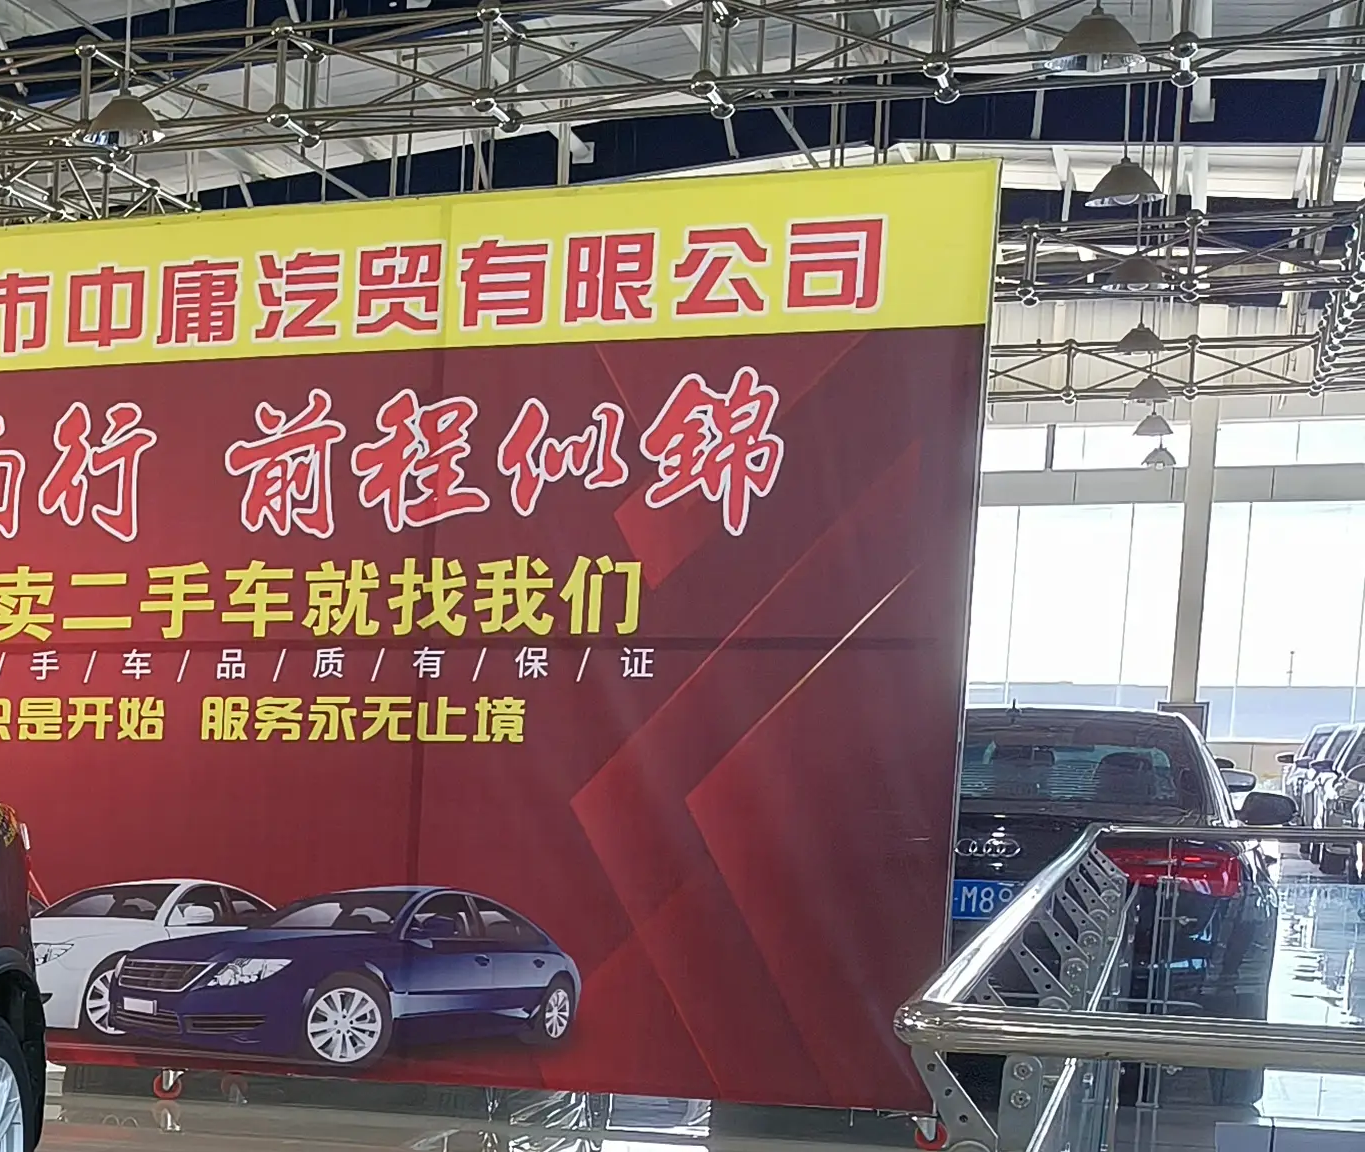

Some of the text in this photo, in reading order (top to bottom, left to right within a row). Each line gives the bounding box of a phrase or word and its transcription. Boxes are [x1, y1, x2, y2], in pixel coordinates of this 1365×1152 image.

[201, 696, 526, 743] 服务永无止境
